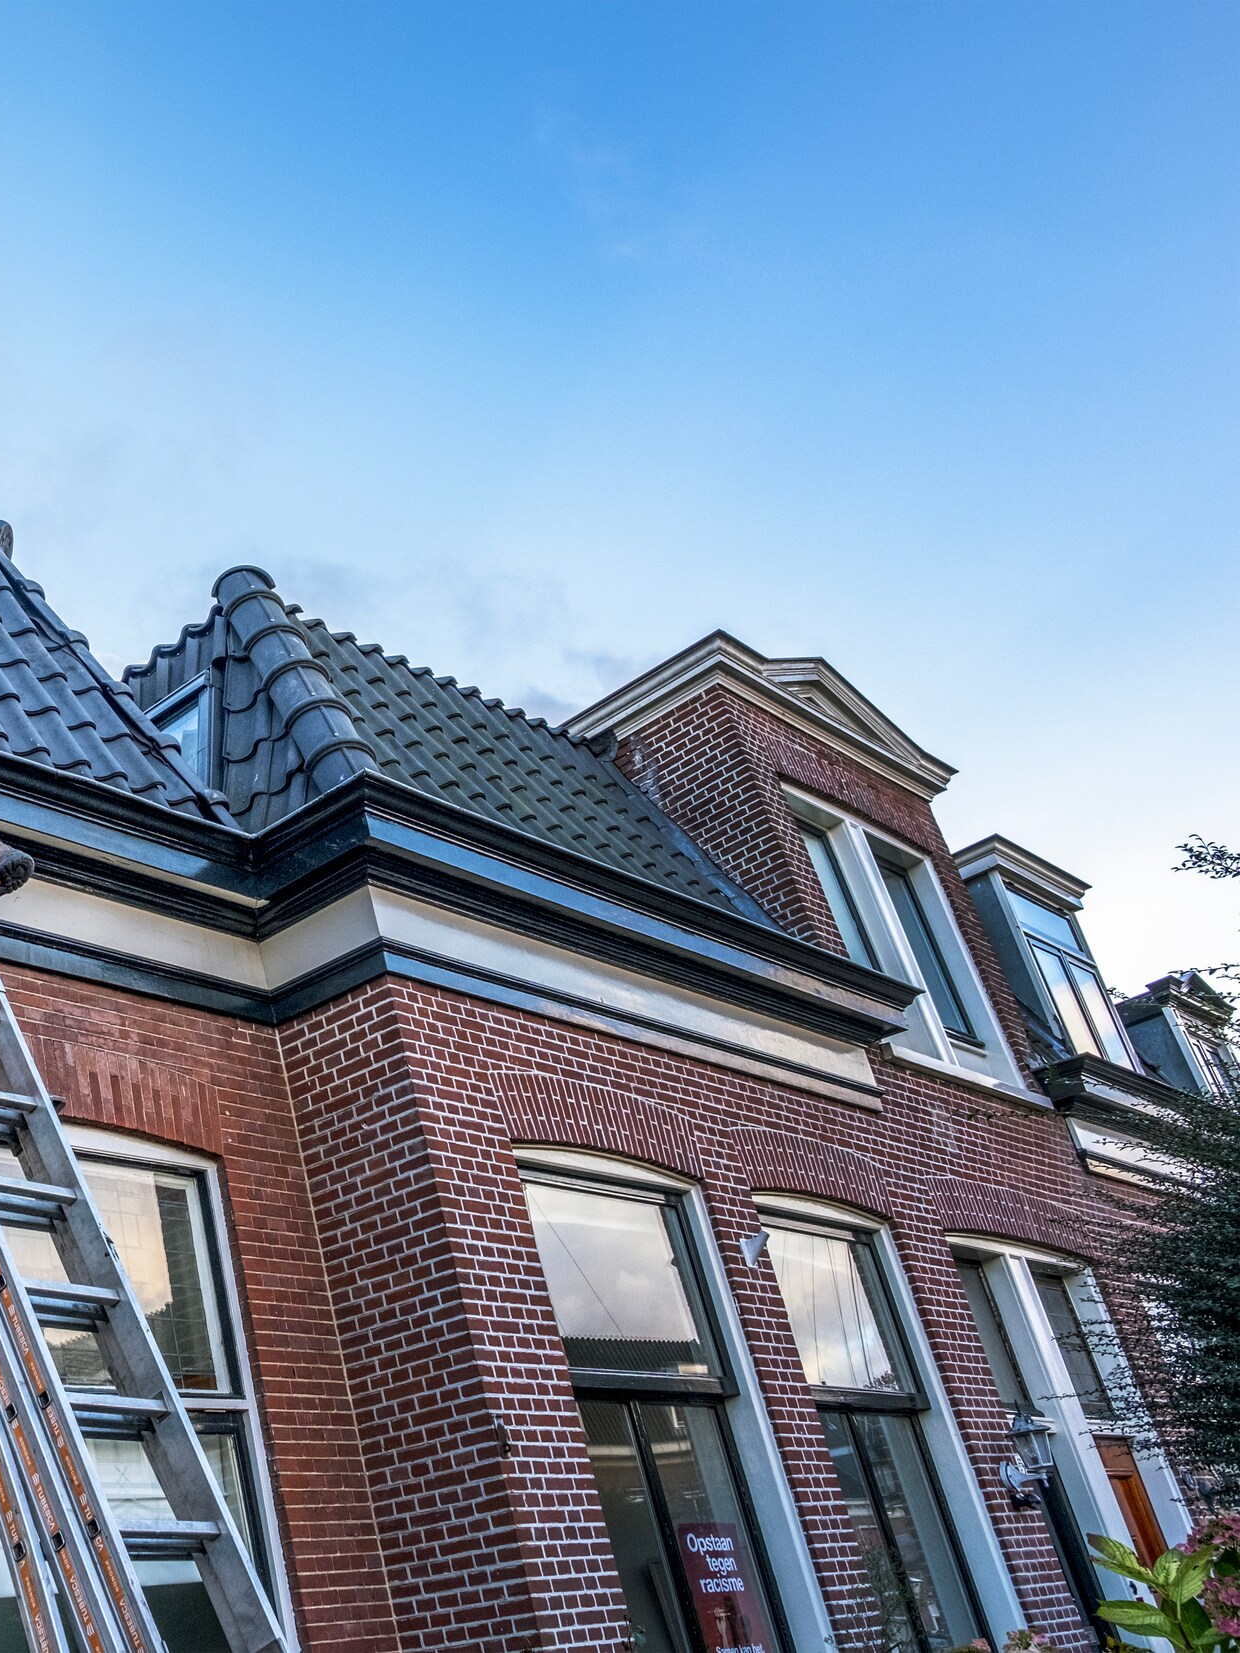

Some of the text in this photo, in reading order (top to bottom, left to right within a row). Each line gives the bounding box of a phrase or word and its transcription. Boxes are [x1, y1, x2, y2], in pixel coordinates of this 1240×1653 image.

[11, 1315, 29, 1354] TUBESCA
[36, 1485, 55, 1529] TUBESCA
[686, 1532, 734, 1556] Opstaan
[105, 1560, 118, 1592] PRONOR
[706, 1554, 737, 1576] tegen
[25, 1576, 36, 1607] PRONOR
[69, 1575, 89, 1622] TUBESCA
[699, 1573, 745, 1593] racisme
[118, 1598, 140, 1646] TUBESCA
